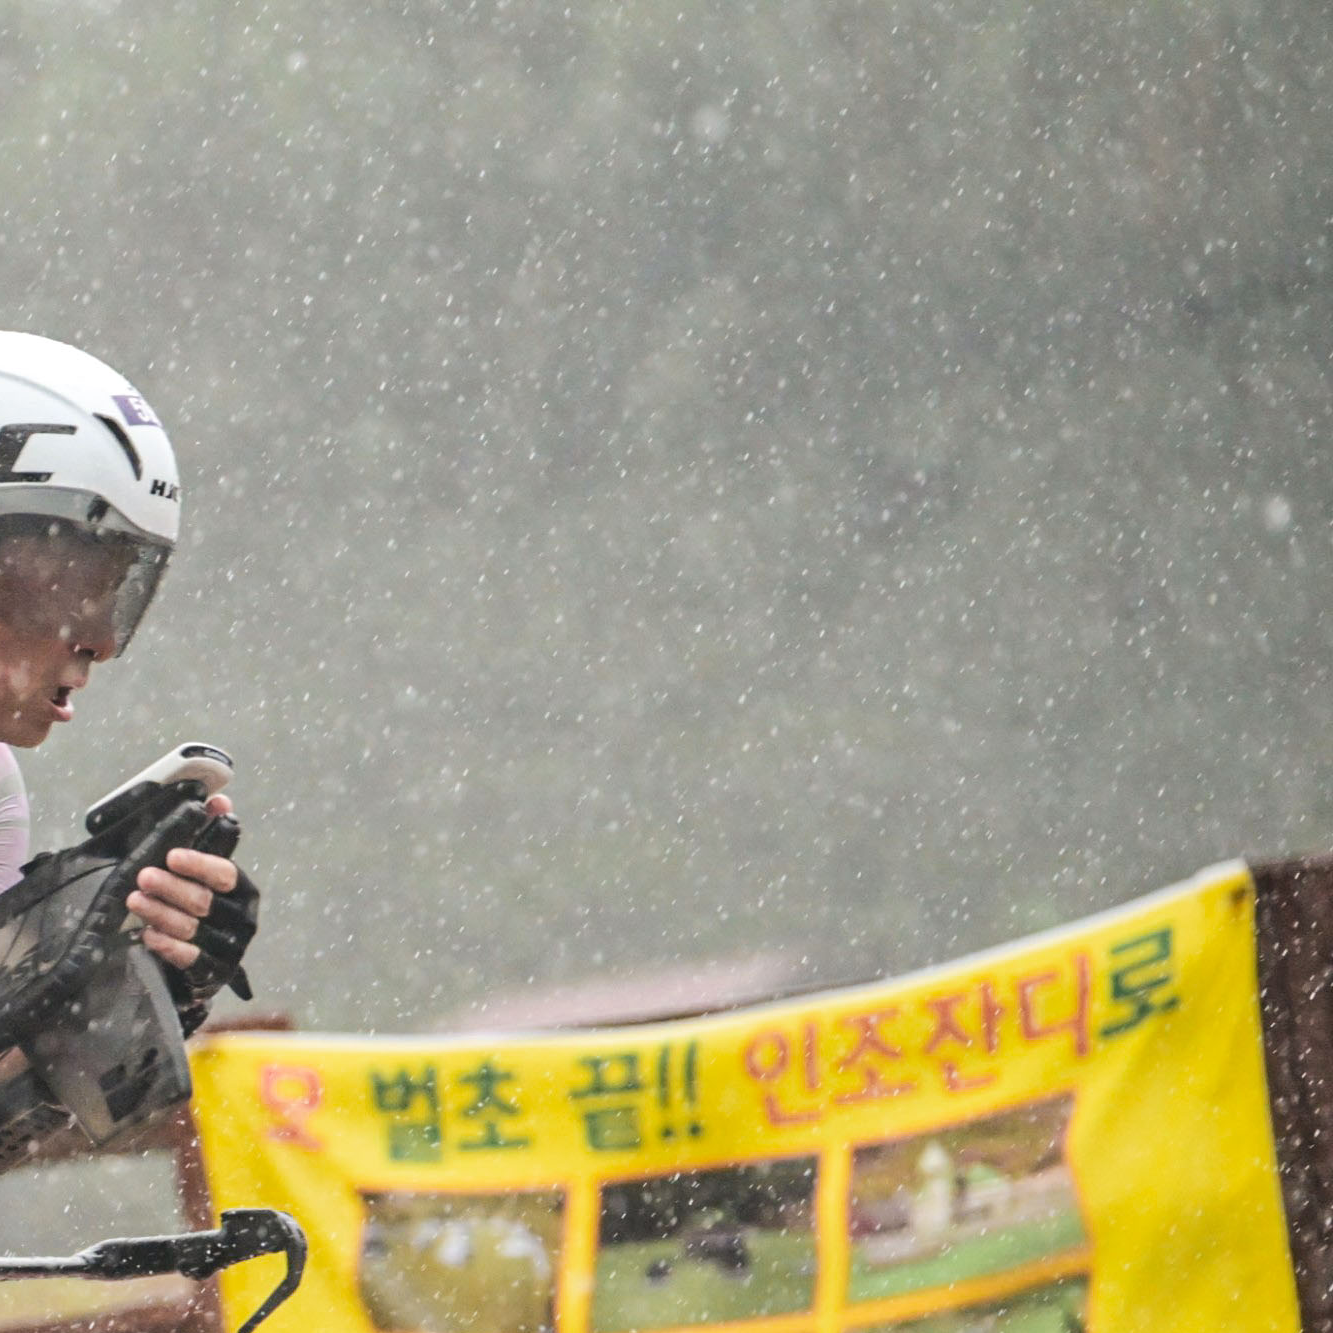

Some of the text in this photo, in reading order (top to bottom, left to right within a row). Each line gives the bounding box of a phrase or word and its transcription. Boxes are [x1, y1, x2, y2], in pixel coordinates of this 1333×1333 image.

[370, 1058, 531, 1163] 벌초
[571, 1040, 704, 1151] 끝!!
[744, 926, 1180, 1127] 인조잔디로
